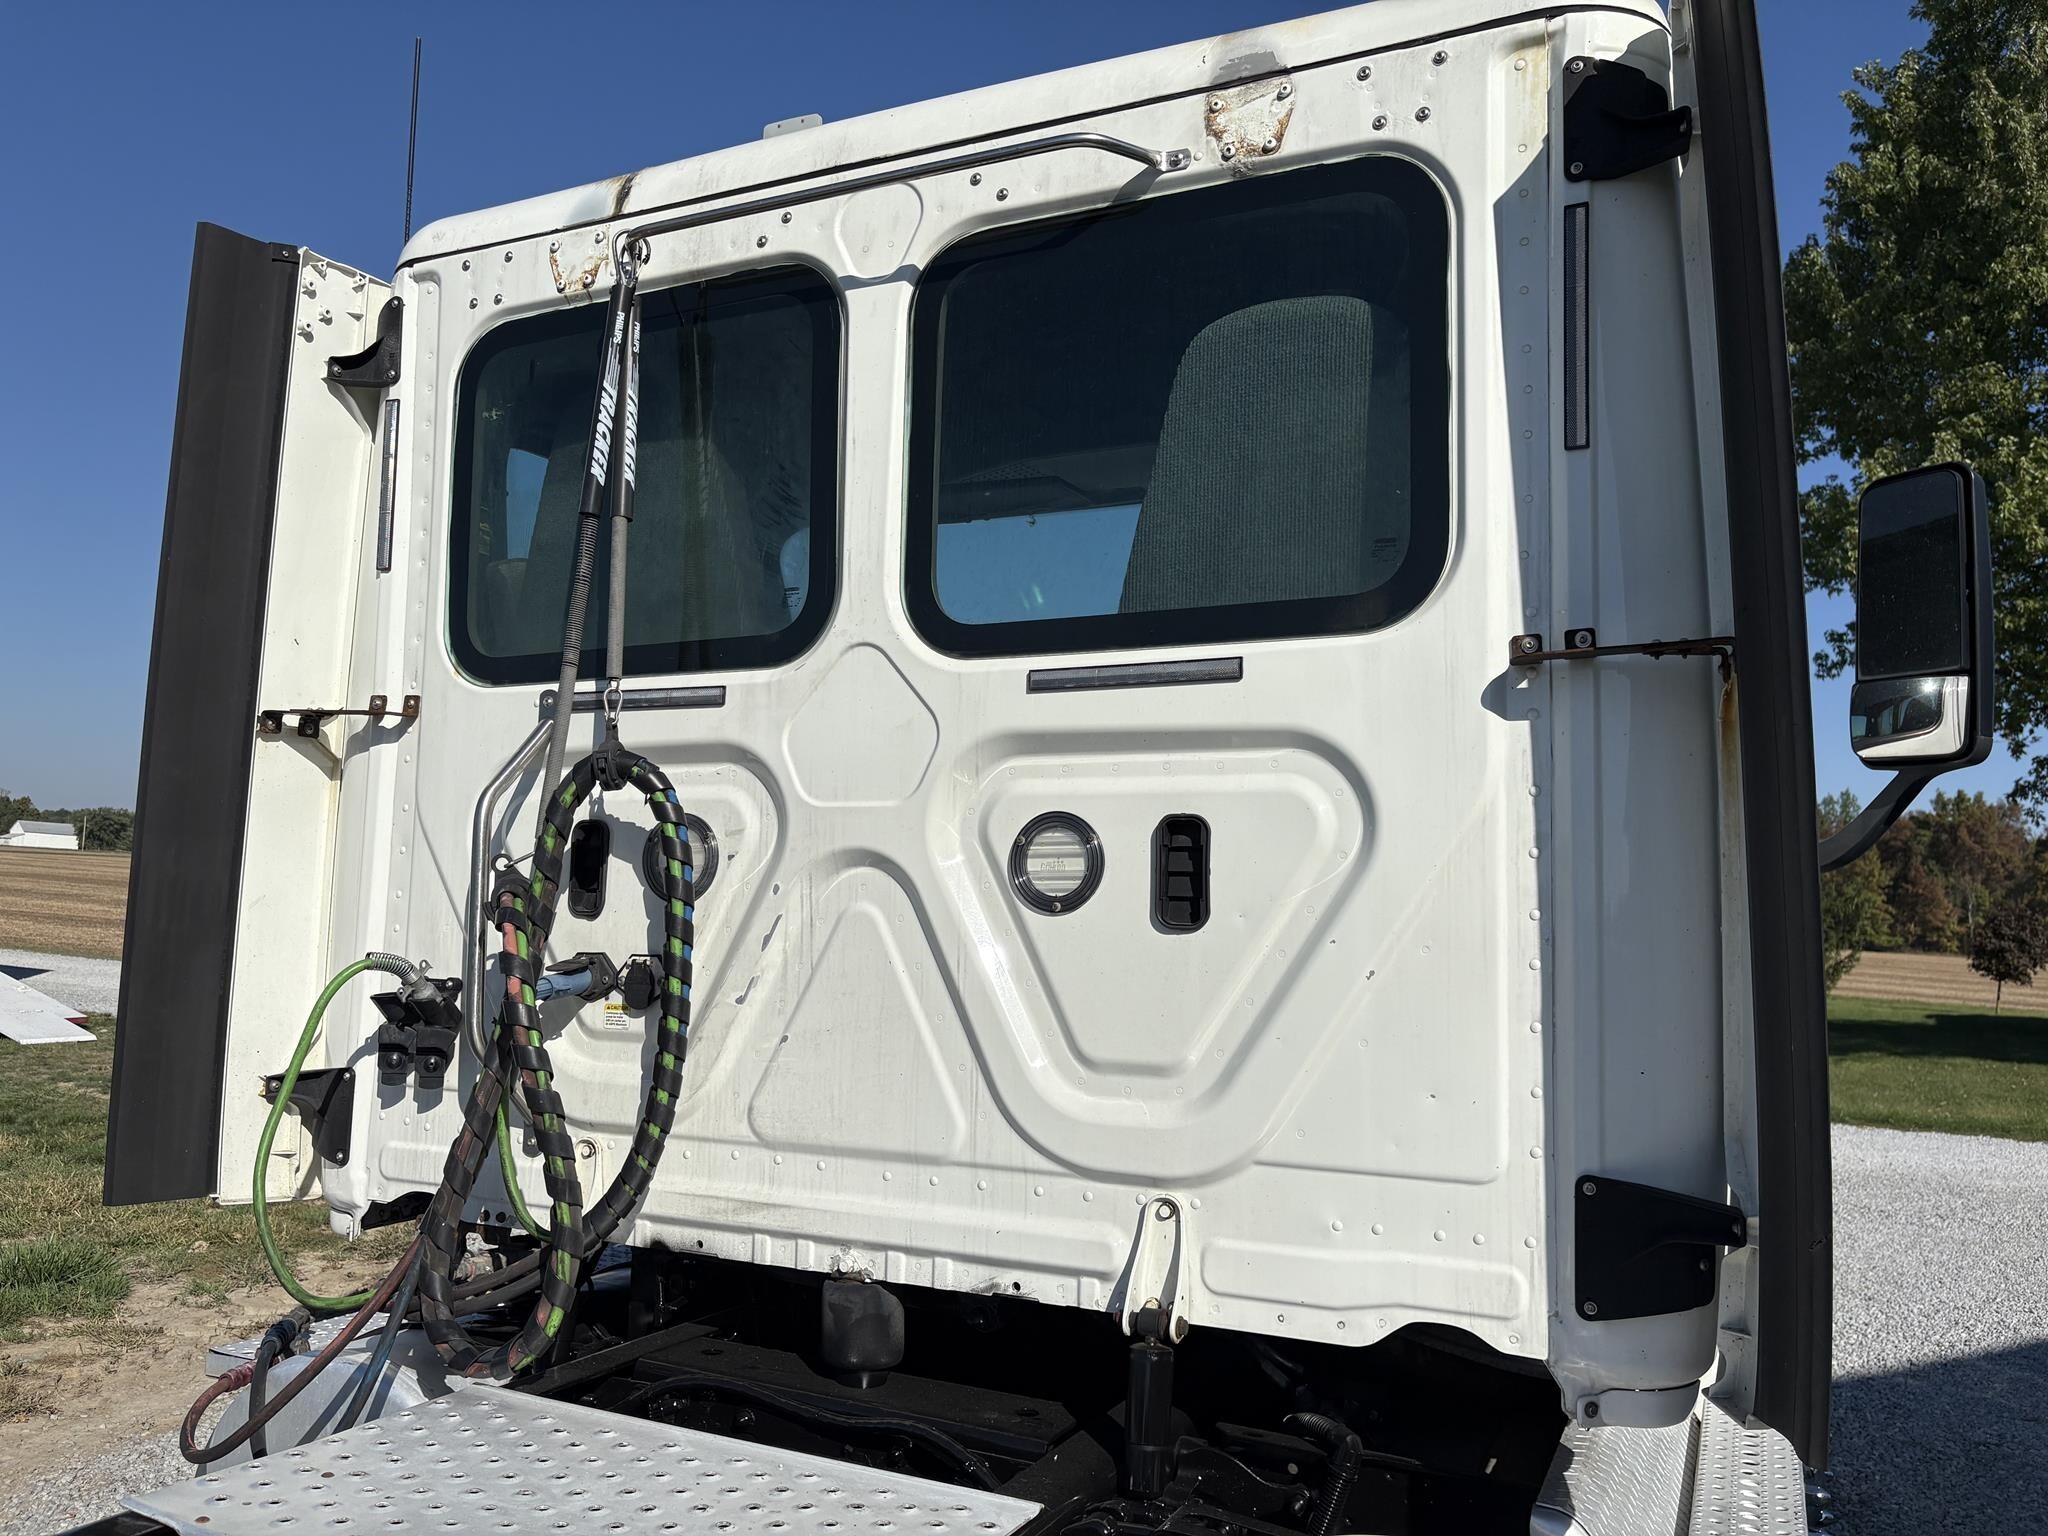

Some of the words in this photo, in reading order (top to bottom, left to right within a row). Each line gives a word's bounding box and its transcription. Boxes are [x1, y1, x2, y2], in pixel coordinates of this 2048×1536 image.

[612, 311, 626, 344] PHILLIPS
[633, 321, 641, 354] PHILLIPS
[590, 380, 618, 487] TRACKER
[624, 388, 639, 492] TRACKER
